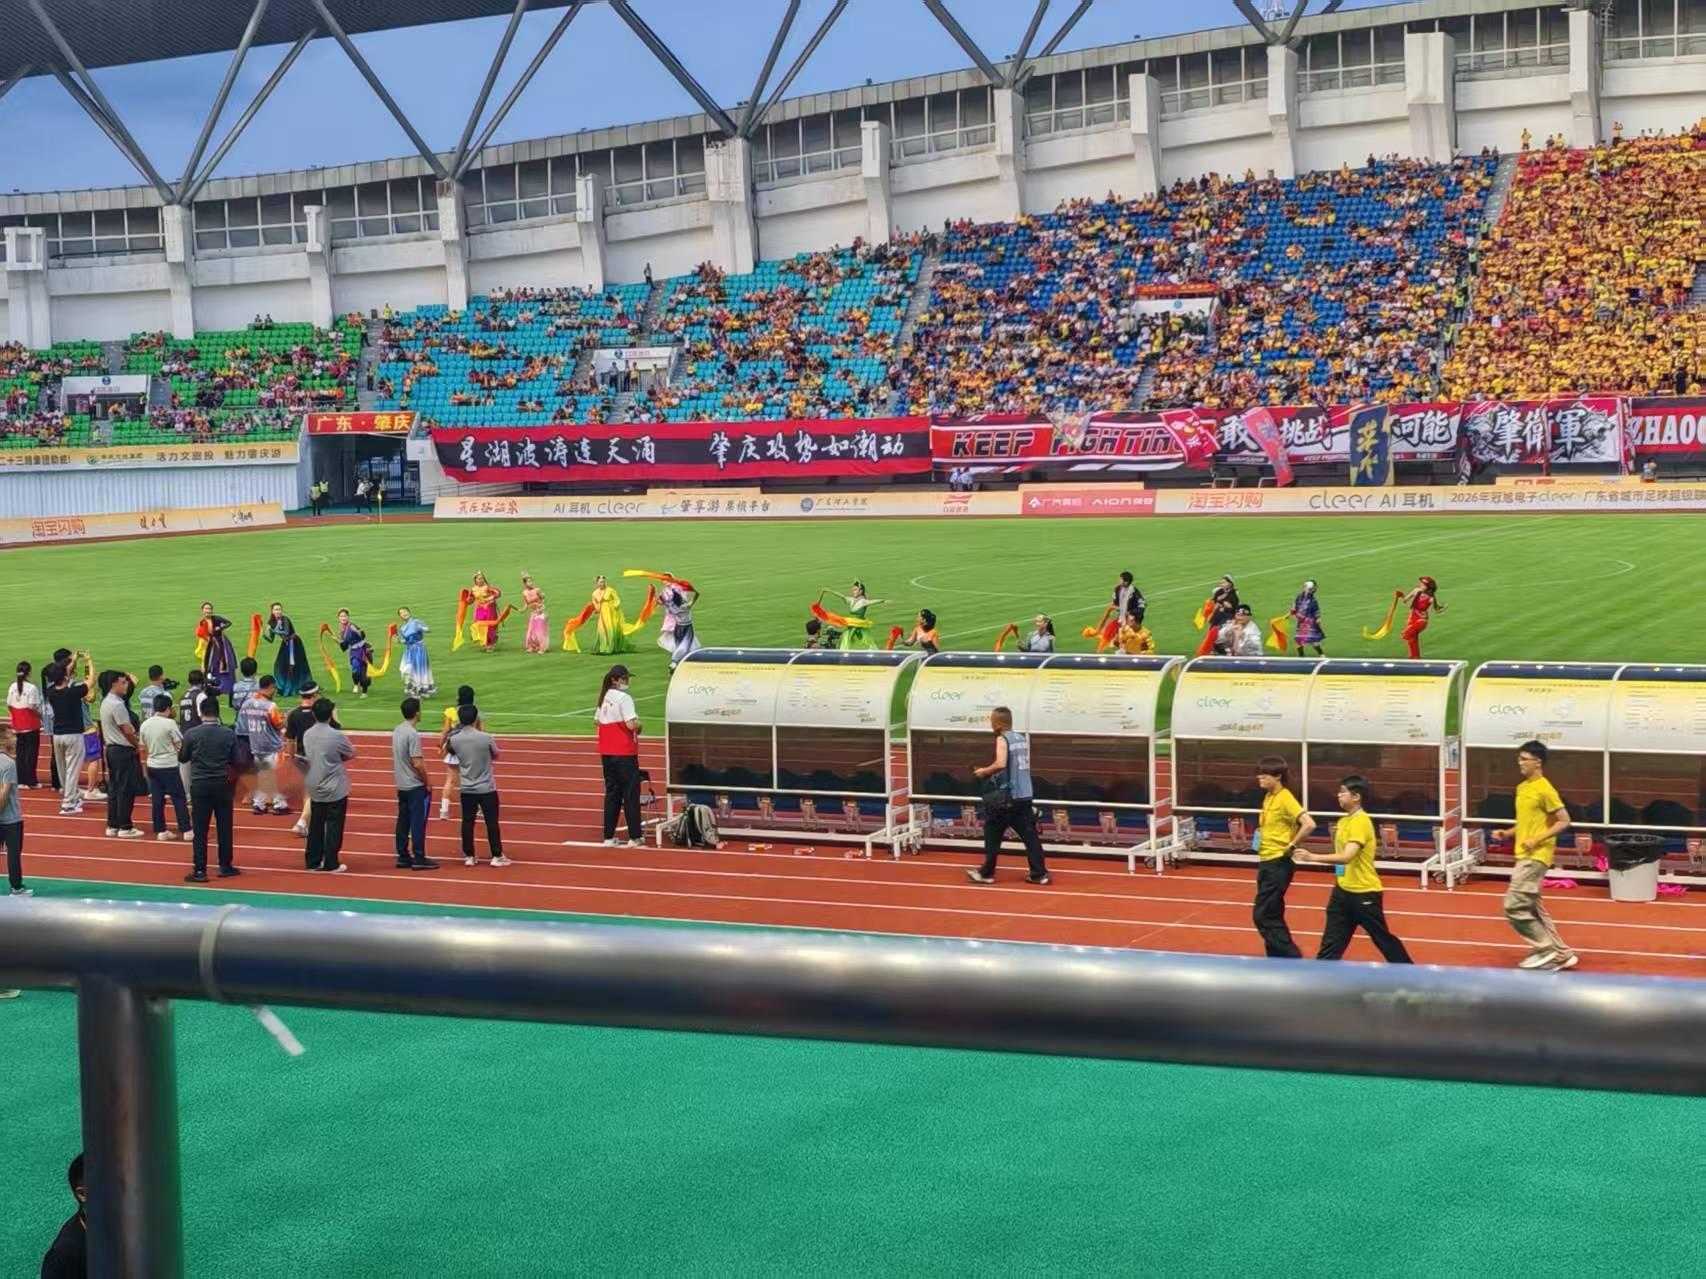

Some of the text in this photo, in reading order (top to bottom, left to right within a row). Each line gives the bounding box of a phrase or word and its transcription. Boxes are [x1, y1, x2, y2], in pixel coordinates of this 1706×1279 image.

[952, 430, 1036, 457] KEEP
[597, 499, 646, 514] cleer
[1188, 492, 1264, 509] 淘宝闪购
[1309, 490, 1373, 509] cleer
[1379, 494, 1397, 508] AI
